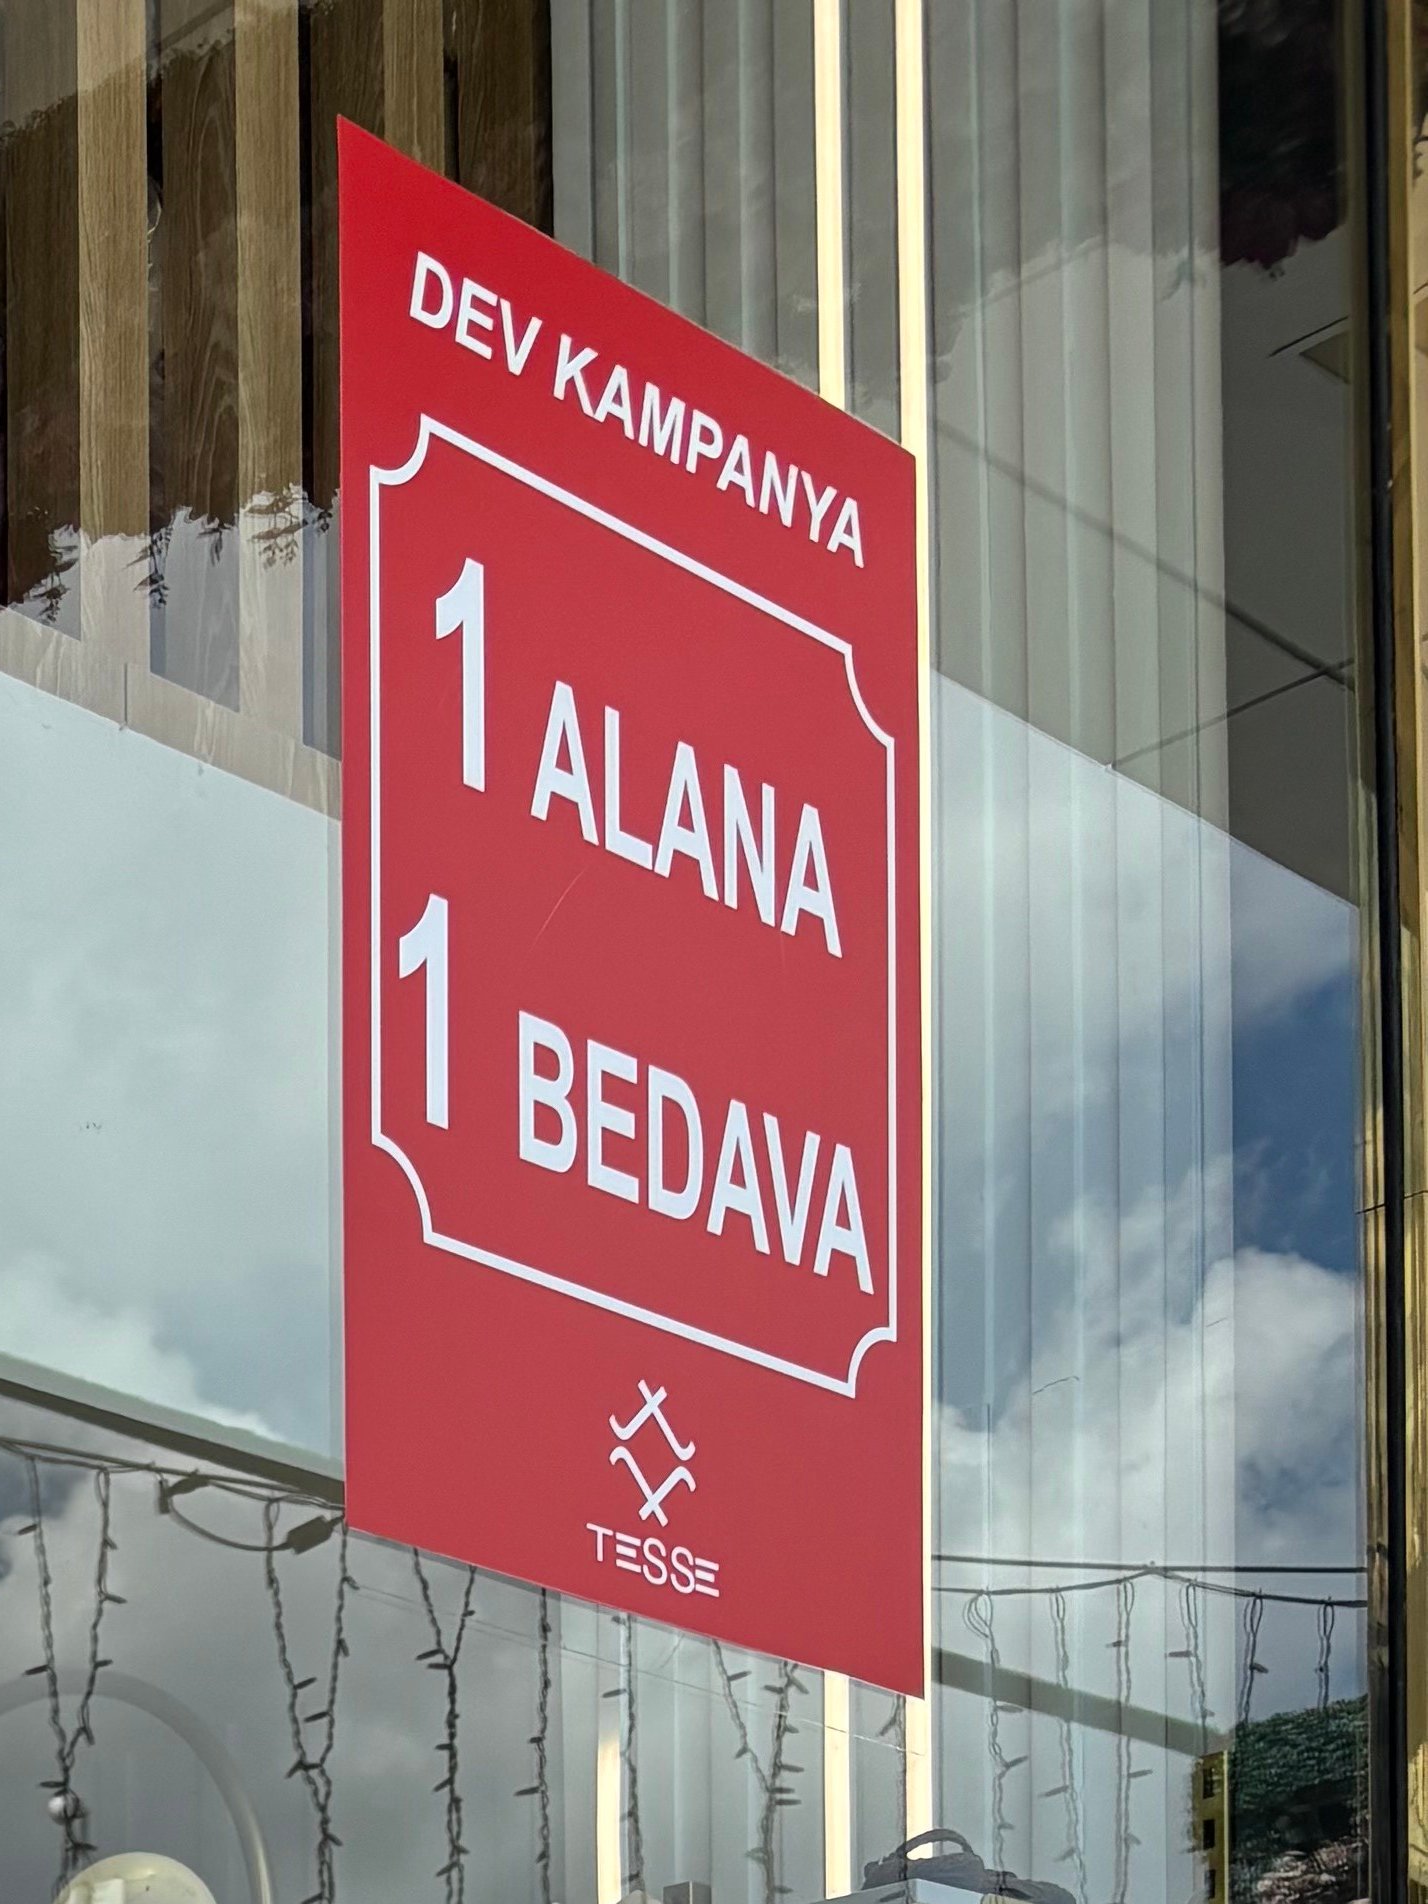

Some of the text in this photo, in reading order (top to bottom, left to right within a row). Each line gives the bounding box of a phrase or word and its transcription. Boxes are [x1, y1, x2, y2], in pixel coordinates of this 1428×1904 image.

[409, 251, 864, 569] DEV KAMPANYA
[435, 557, 843, 958] 1 ALANA
[398, 893, 875, 1295] 1 BEDAVA
[586, 1522, 720, 1598] TESSE
